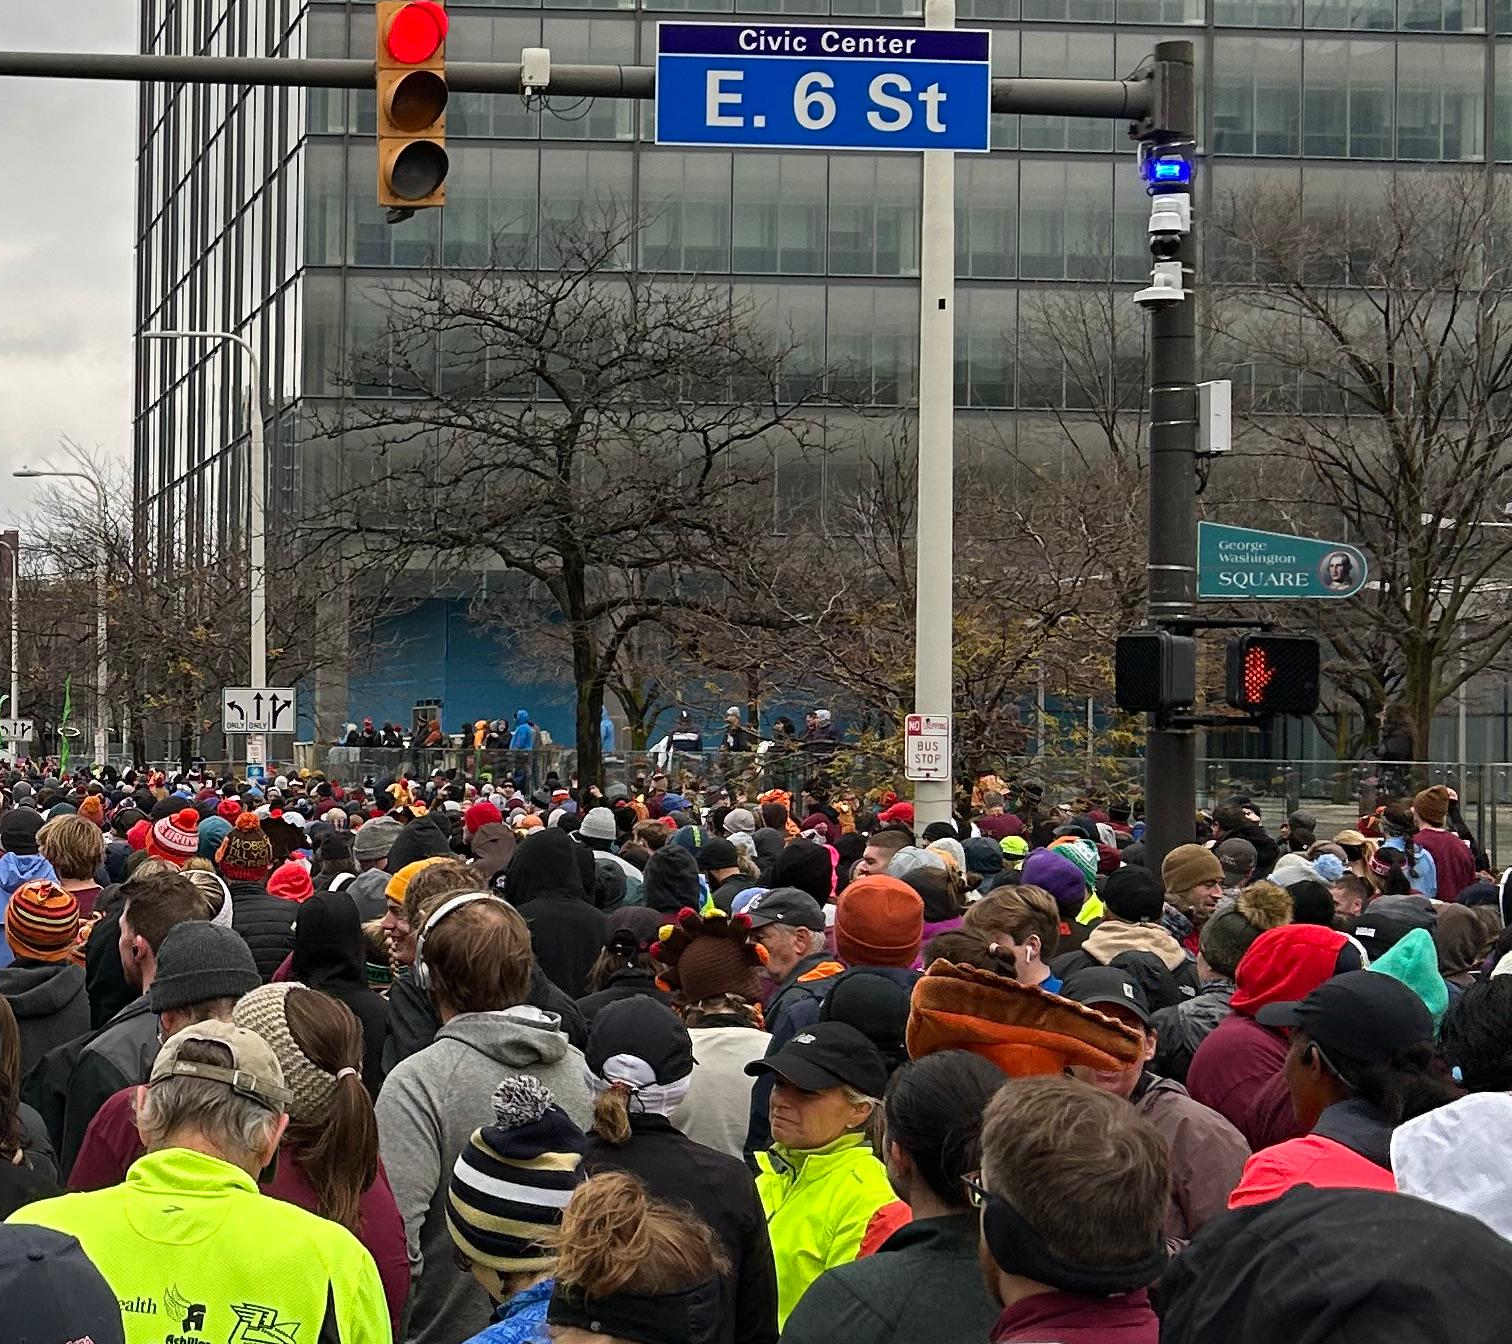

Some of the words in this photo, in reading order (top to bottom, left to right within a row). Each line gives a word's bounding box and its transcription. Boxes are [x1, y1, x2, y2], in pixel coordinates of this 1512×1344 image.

[738, 29, 807, 52] Civic
[820, 31, 916, 54] Center
[705, 69, 766, 128] E.
[793, 71, 837, 131] 6
[866, 72, 948, 133] St
[1218, 540, 1268, 552] George
[1218, 552, 1297, 566] Washington
[1218, 571, 1310, 589] SQUARE
[917, 741, 939, 751] BUS
[914, 754, 941, 764] STOP
